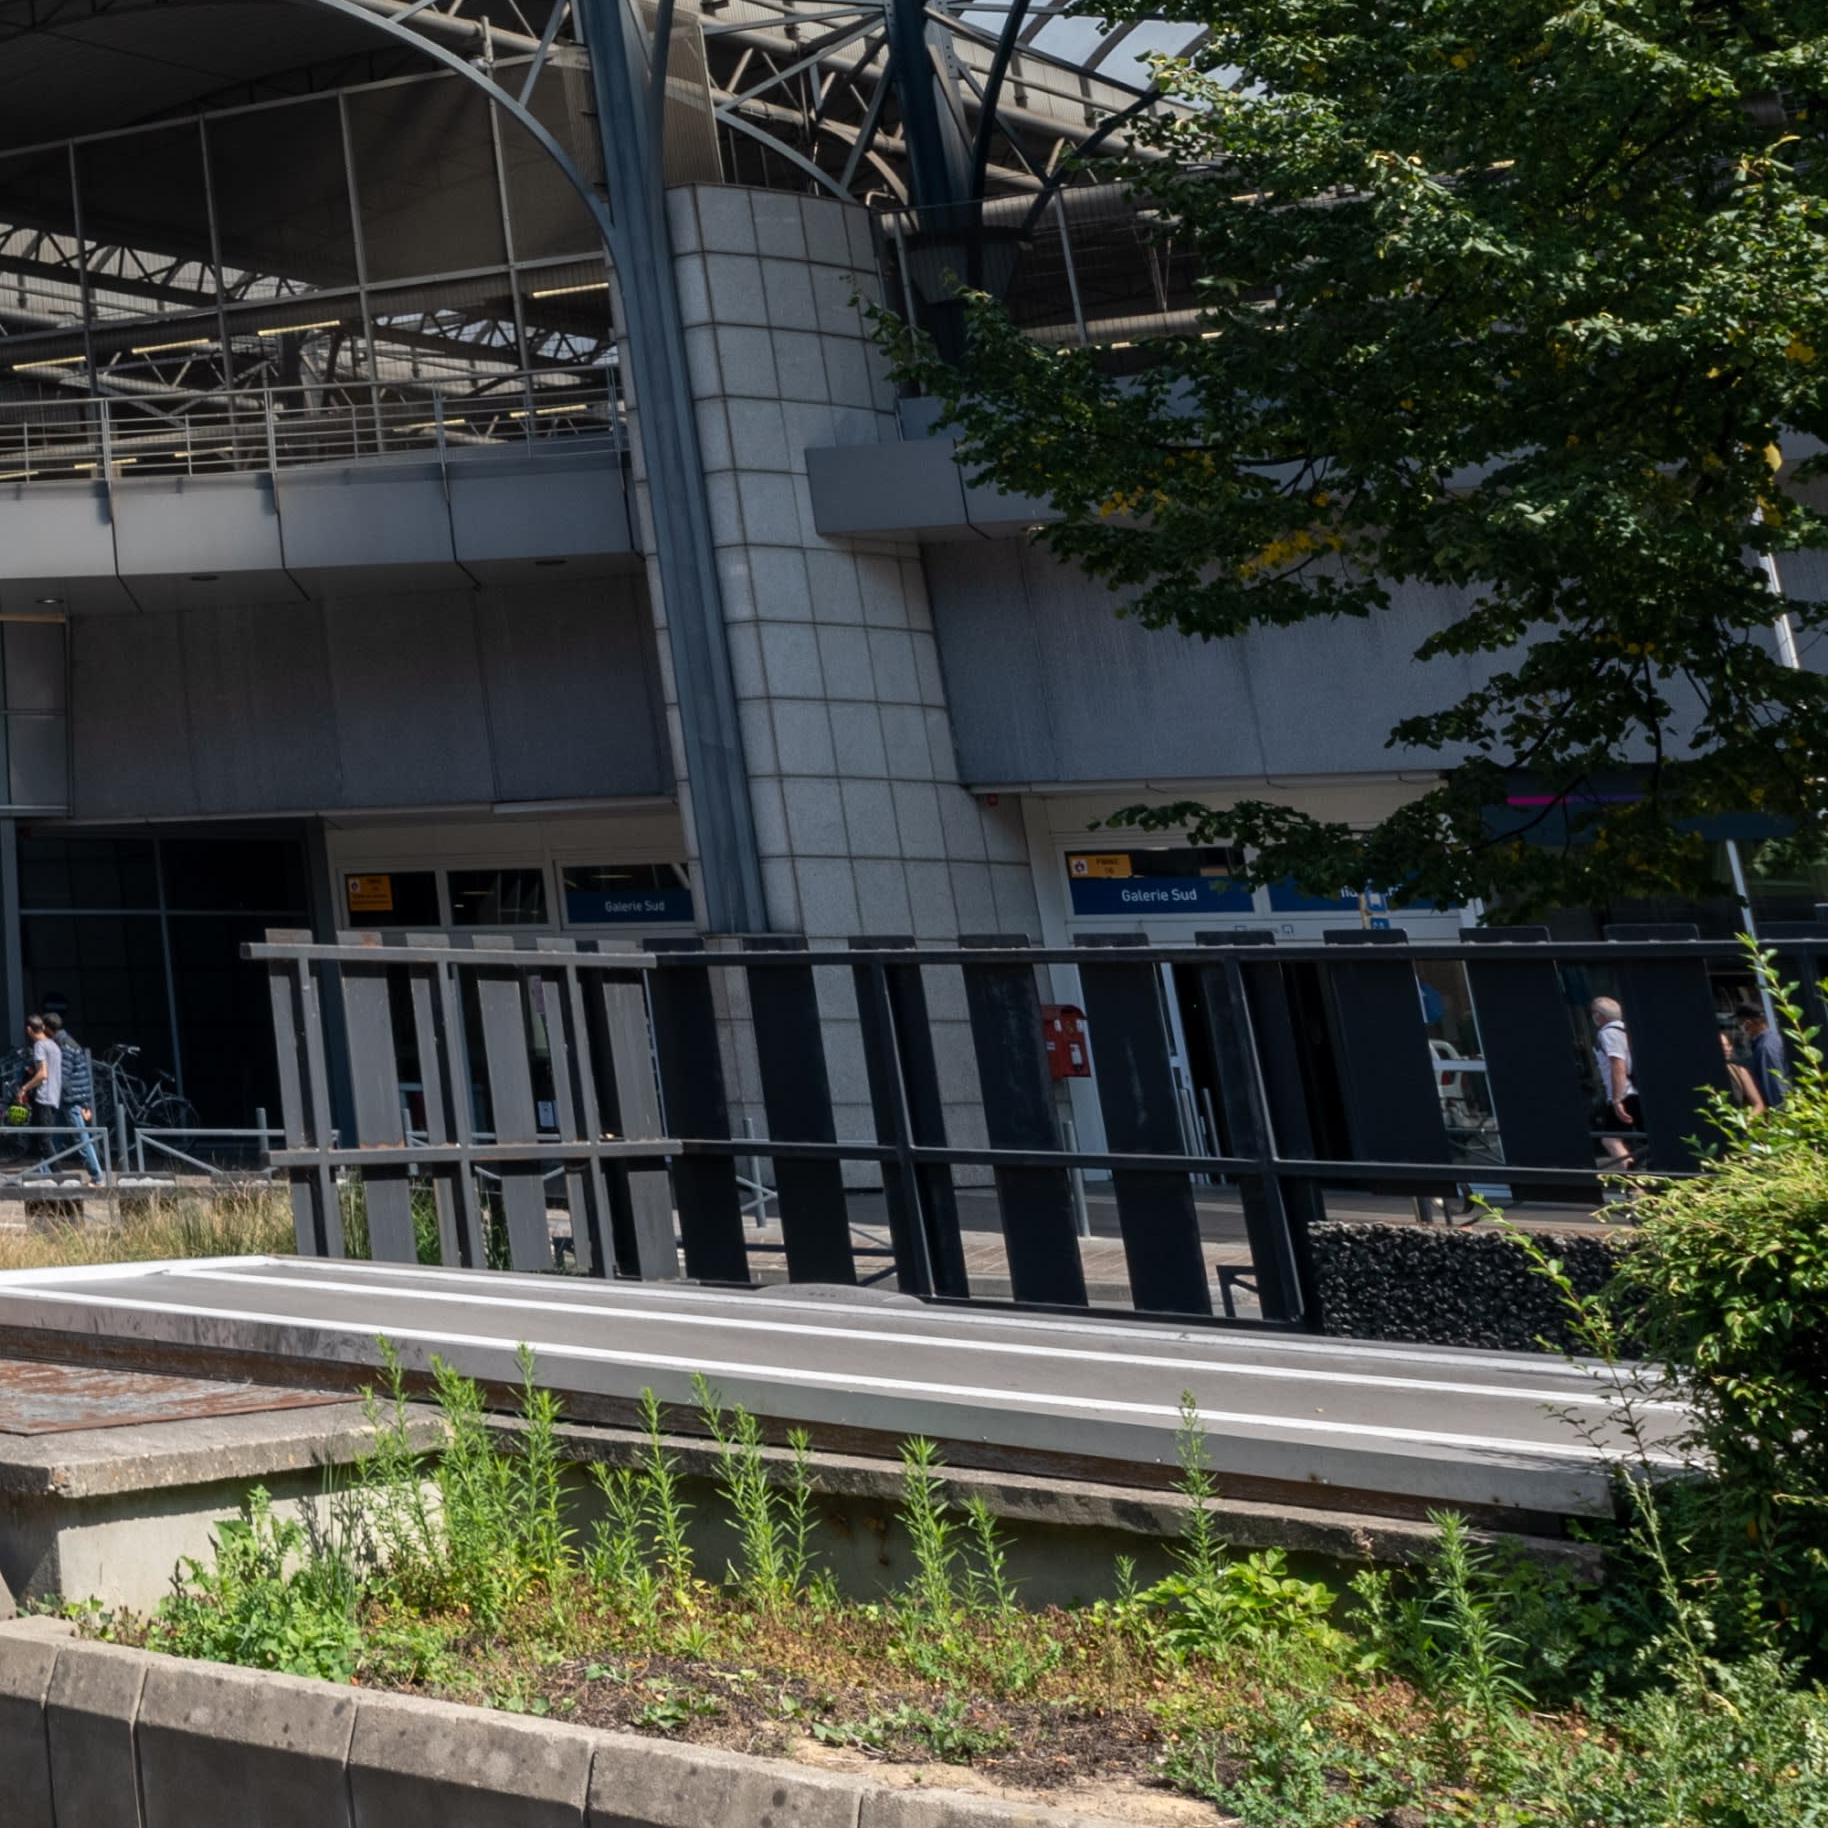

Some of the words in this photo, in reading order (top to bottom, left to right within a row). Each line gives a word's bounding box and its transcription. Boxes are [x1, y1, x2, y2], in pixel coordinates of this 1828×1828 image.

[1121, 889, 1169, 902] Galerie
[1171, 888, 1198, 901] Sud
[604, 900, 643, 912] Galerie
[644, 899, 665, 911] Sud
